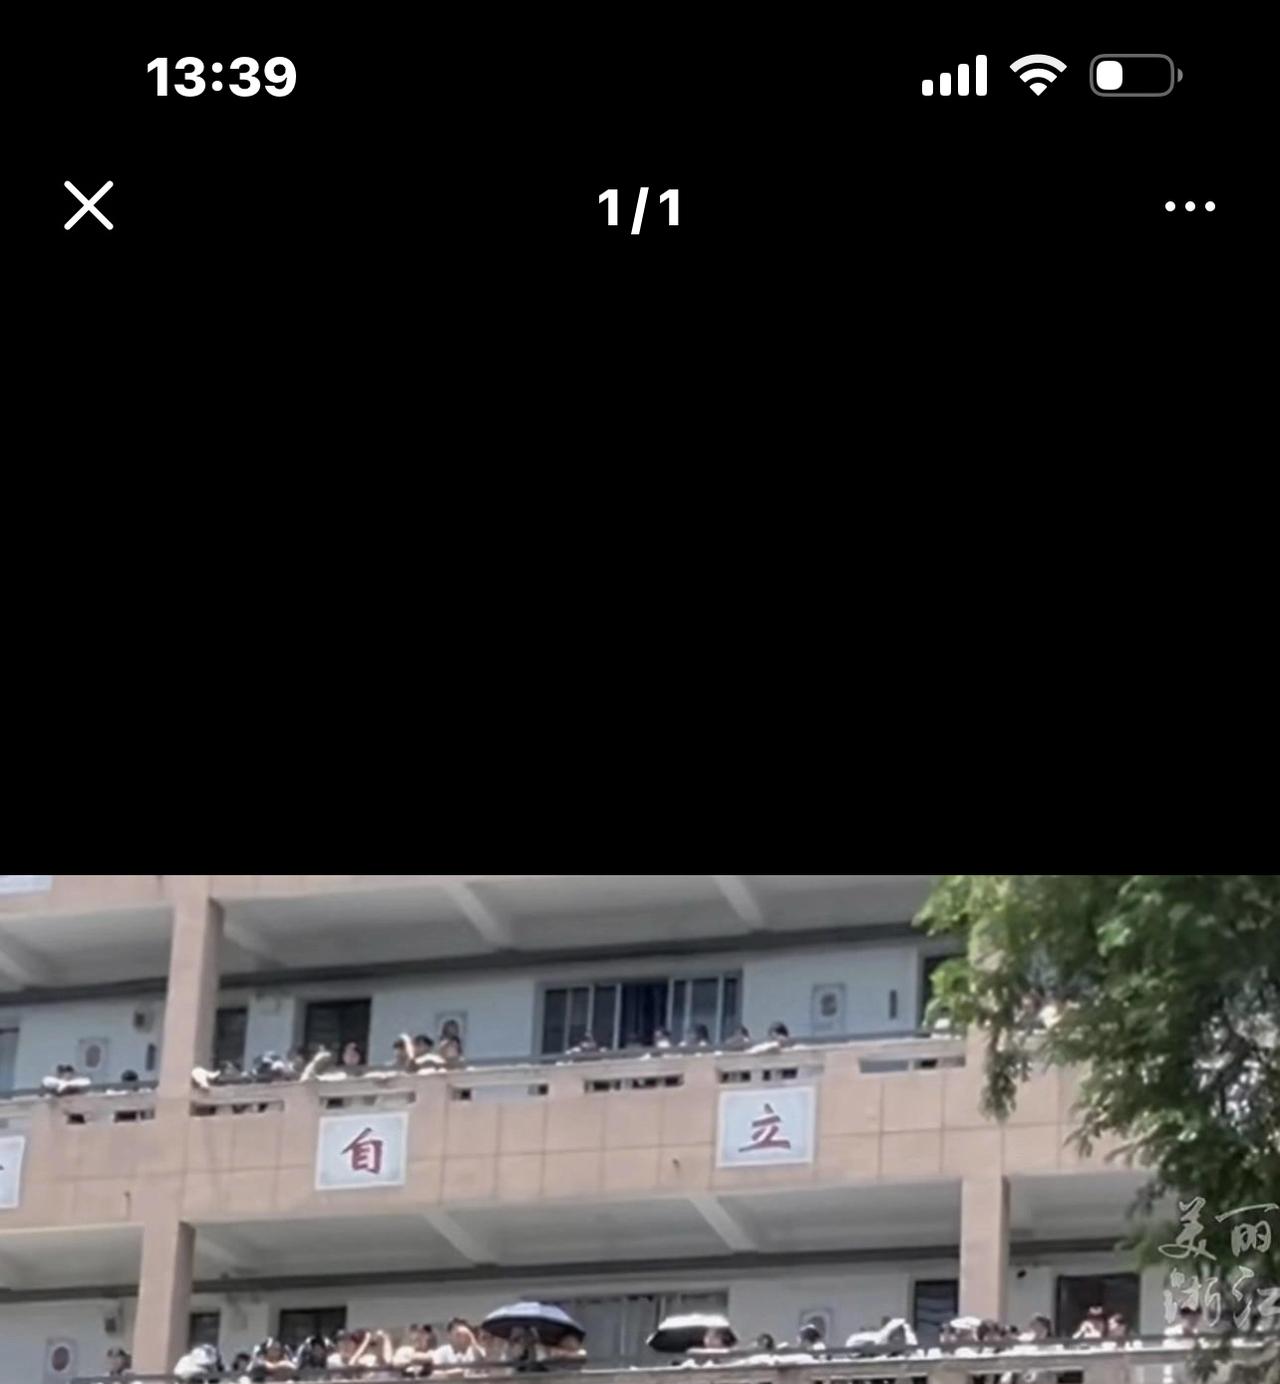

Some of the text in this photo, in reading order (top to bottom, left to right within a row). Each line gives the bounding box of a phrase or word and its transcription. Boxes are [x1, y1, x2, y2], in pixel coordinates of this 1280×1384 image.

[146, 57, 297, 98] 13:39
[341, 1103, 791, 1174] 自 立
